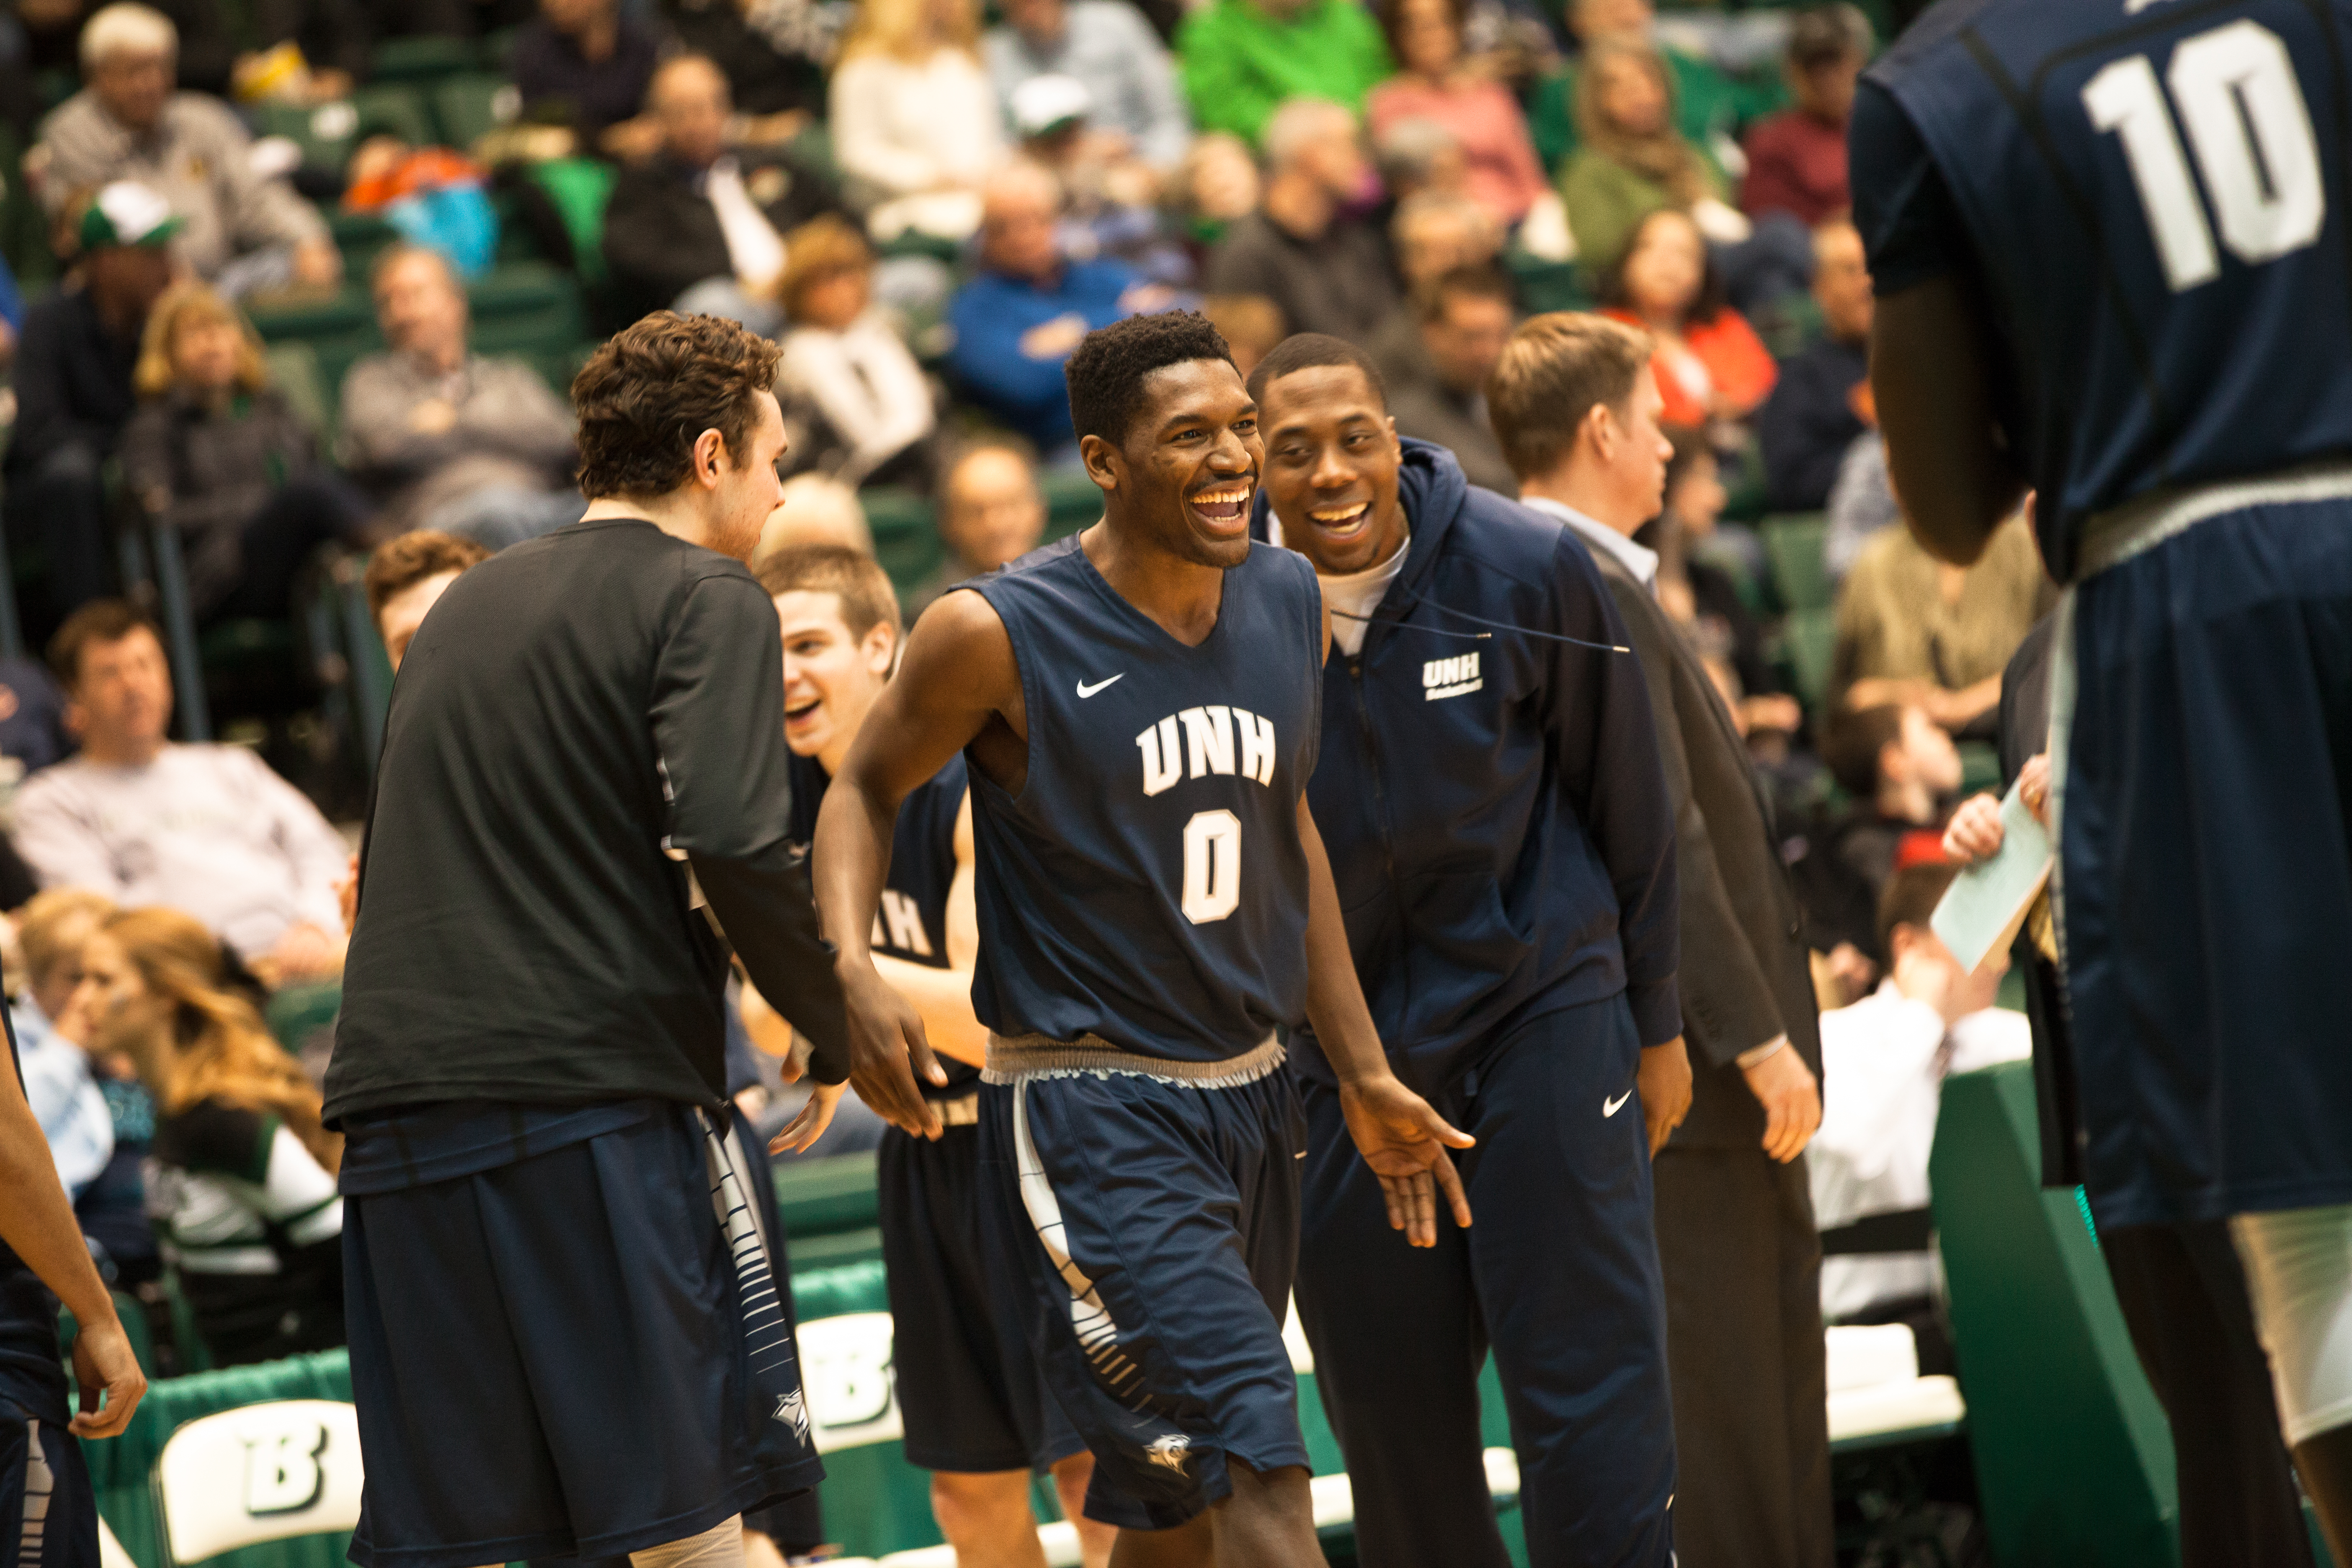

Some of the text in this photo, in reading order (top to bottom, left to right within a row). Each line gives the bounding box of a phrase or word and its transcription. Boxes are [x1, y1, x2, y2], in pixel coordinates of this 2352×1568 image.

[2081, 18, 2326, 294] 10
[1423, 652, 1479, 688] UNH
[1136, 705, 1276, 797] UNH
[1182, 809, 1241, 925] 0
[871, 889, 934, 957] H
[813, 1336, 895, 1431] B
[240, 1423, 328, 1519] B
